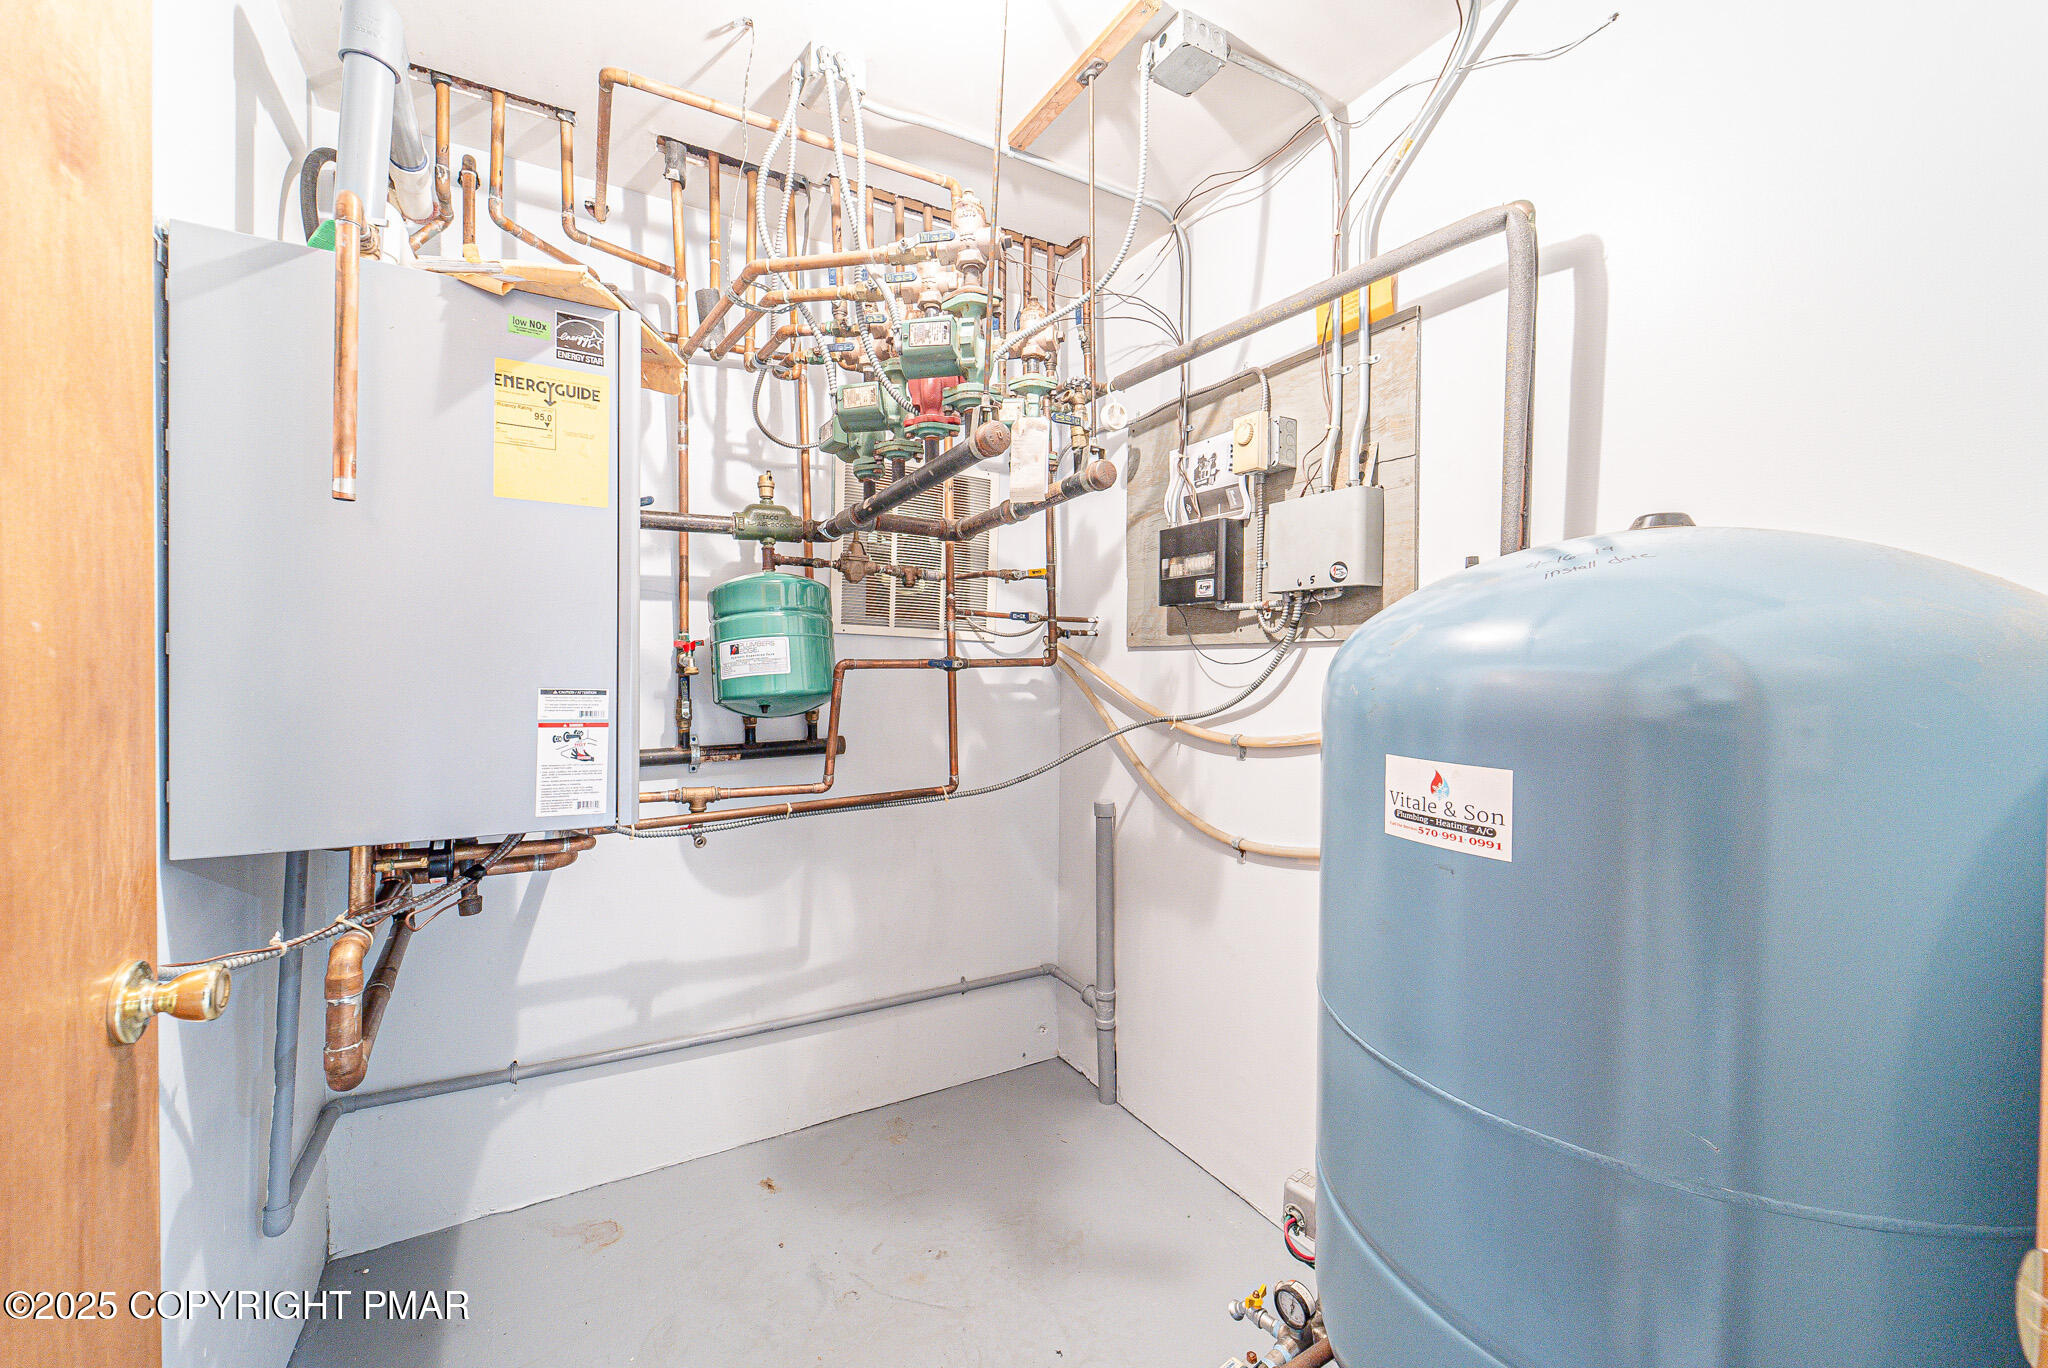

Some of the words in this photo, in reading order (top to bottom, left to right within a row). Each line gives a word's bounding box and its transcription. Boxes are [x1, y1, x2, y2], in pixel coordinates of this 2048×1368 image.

[512, 316, 527, 326] low
[529, 320, 547, 331] NOx
[557, 351, 584, 362] ENERGY
[585, 355, 603, 366] STAR
[494, 372, 601, 404] ENERGYGUIDE
[534, 412, 552, 422] 95.0
[1310, 575, 1315, 584] 5
[1544, 560, 1596, 581] install
[1390, 789, 1437, 814] Vitale
[1444, 801, 1457, 818] &
[1464, 804, 1506, 826] Son
[1396, 810, 1429, 825] Plumbing
[1435, 817, 1468, 833] Heating
[1476, 826, 1494, 836] A/C
